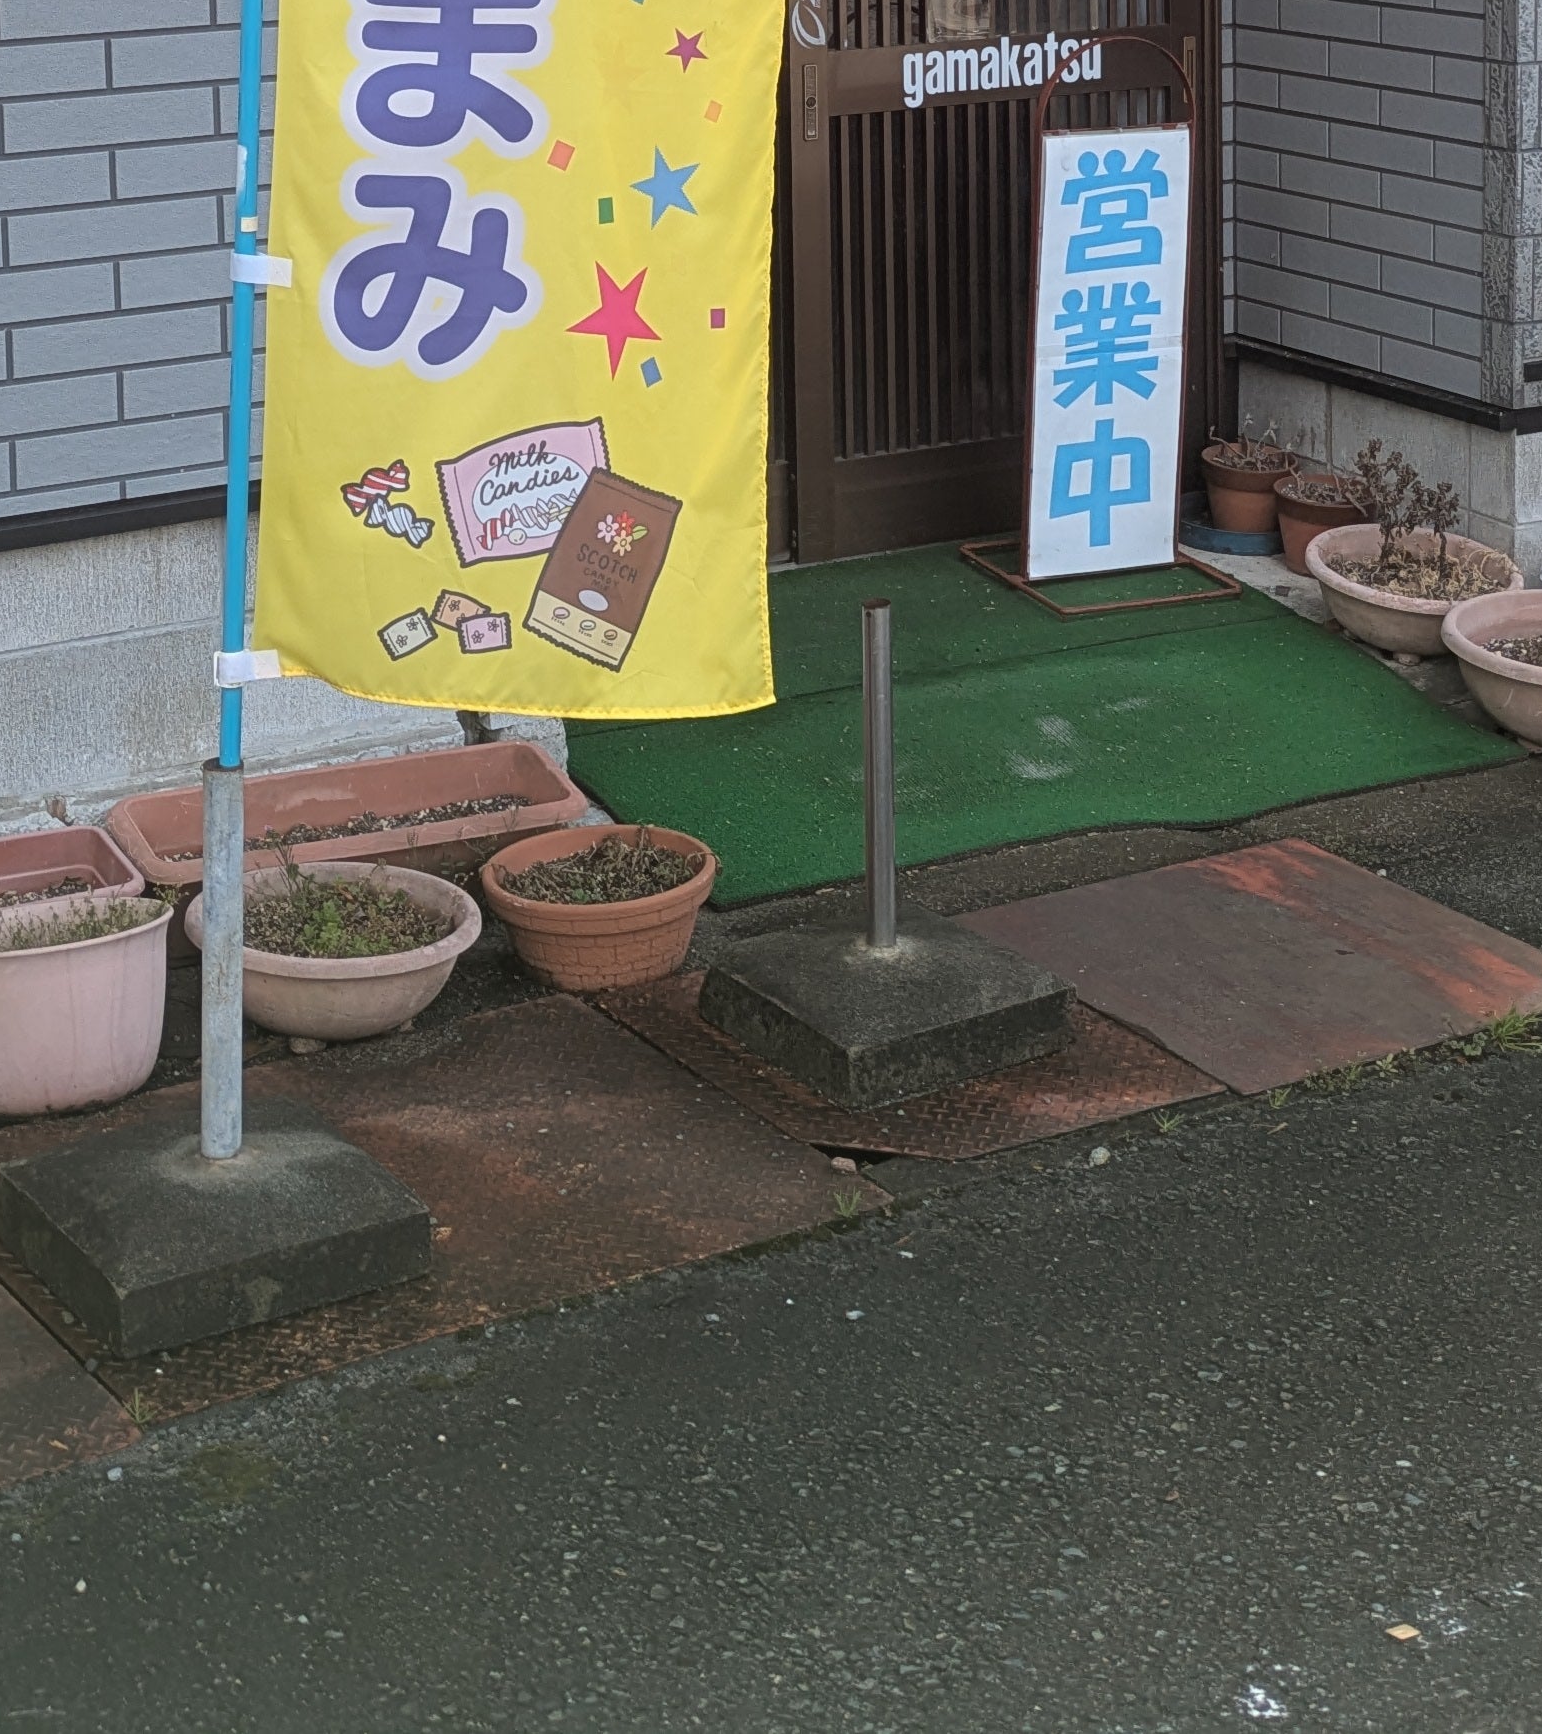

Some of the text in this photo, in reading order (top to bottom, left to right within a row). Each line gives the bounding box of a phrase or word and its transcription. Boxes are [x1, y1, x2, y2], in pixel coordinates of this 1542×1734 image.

[903, 31, 1102, 108] gamakatsu
[1048, 148, 1169, 547] 営業中
[489, 440, 557, 477] Milk
[480, 466, 580, 506] Candies
[577, 543, 639, 584] SCOTCH
